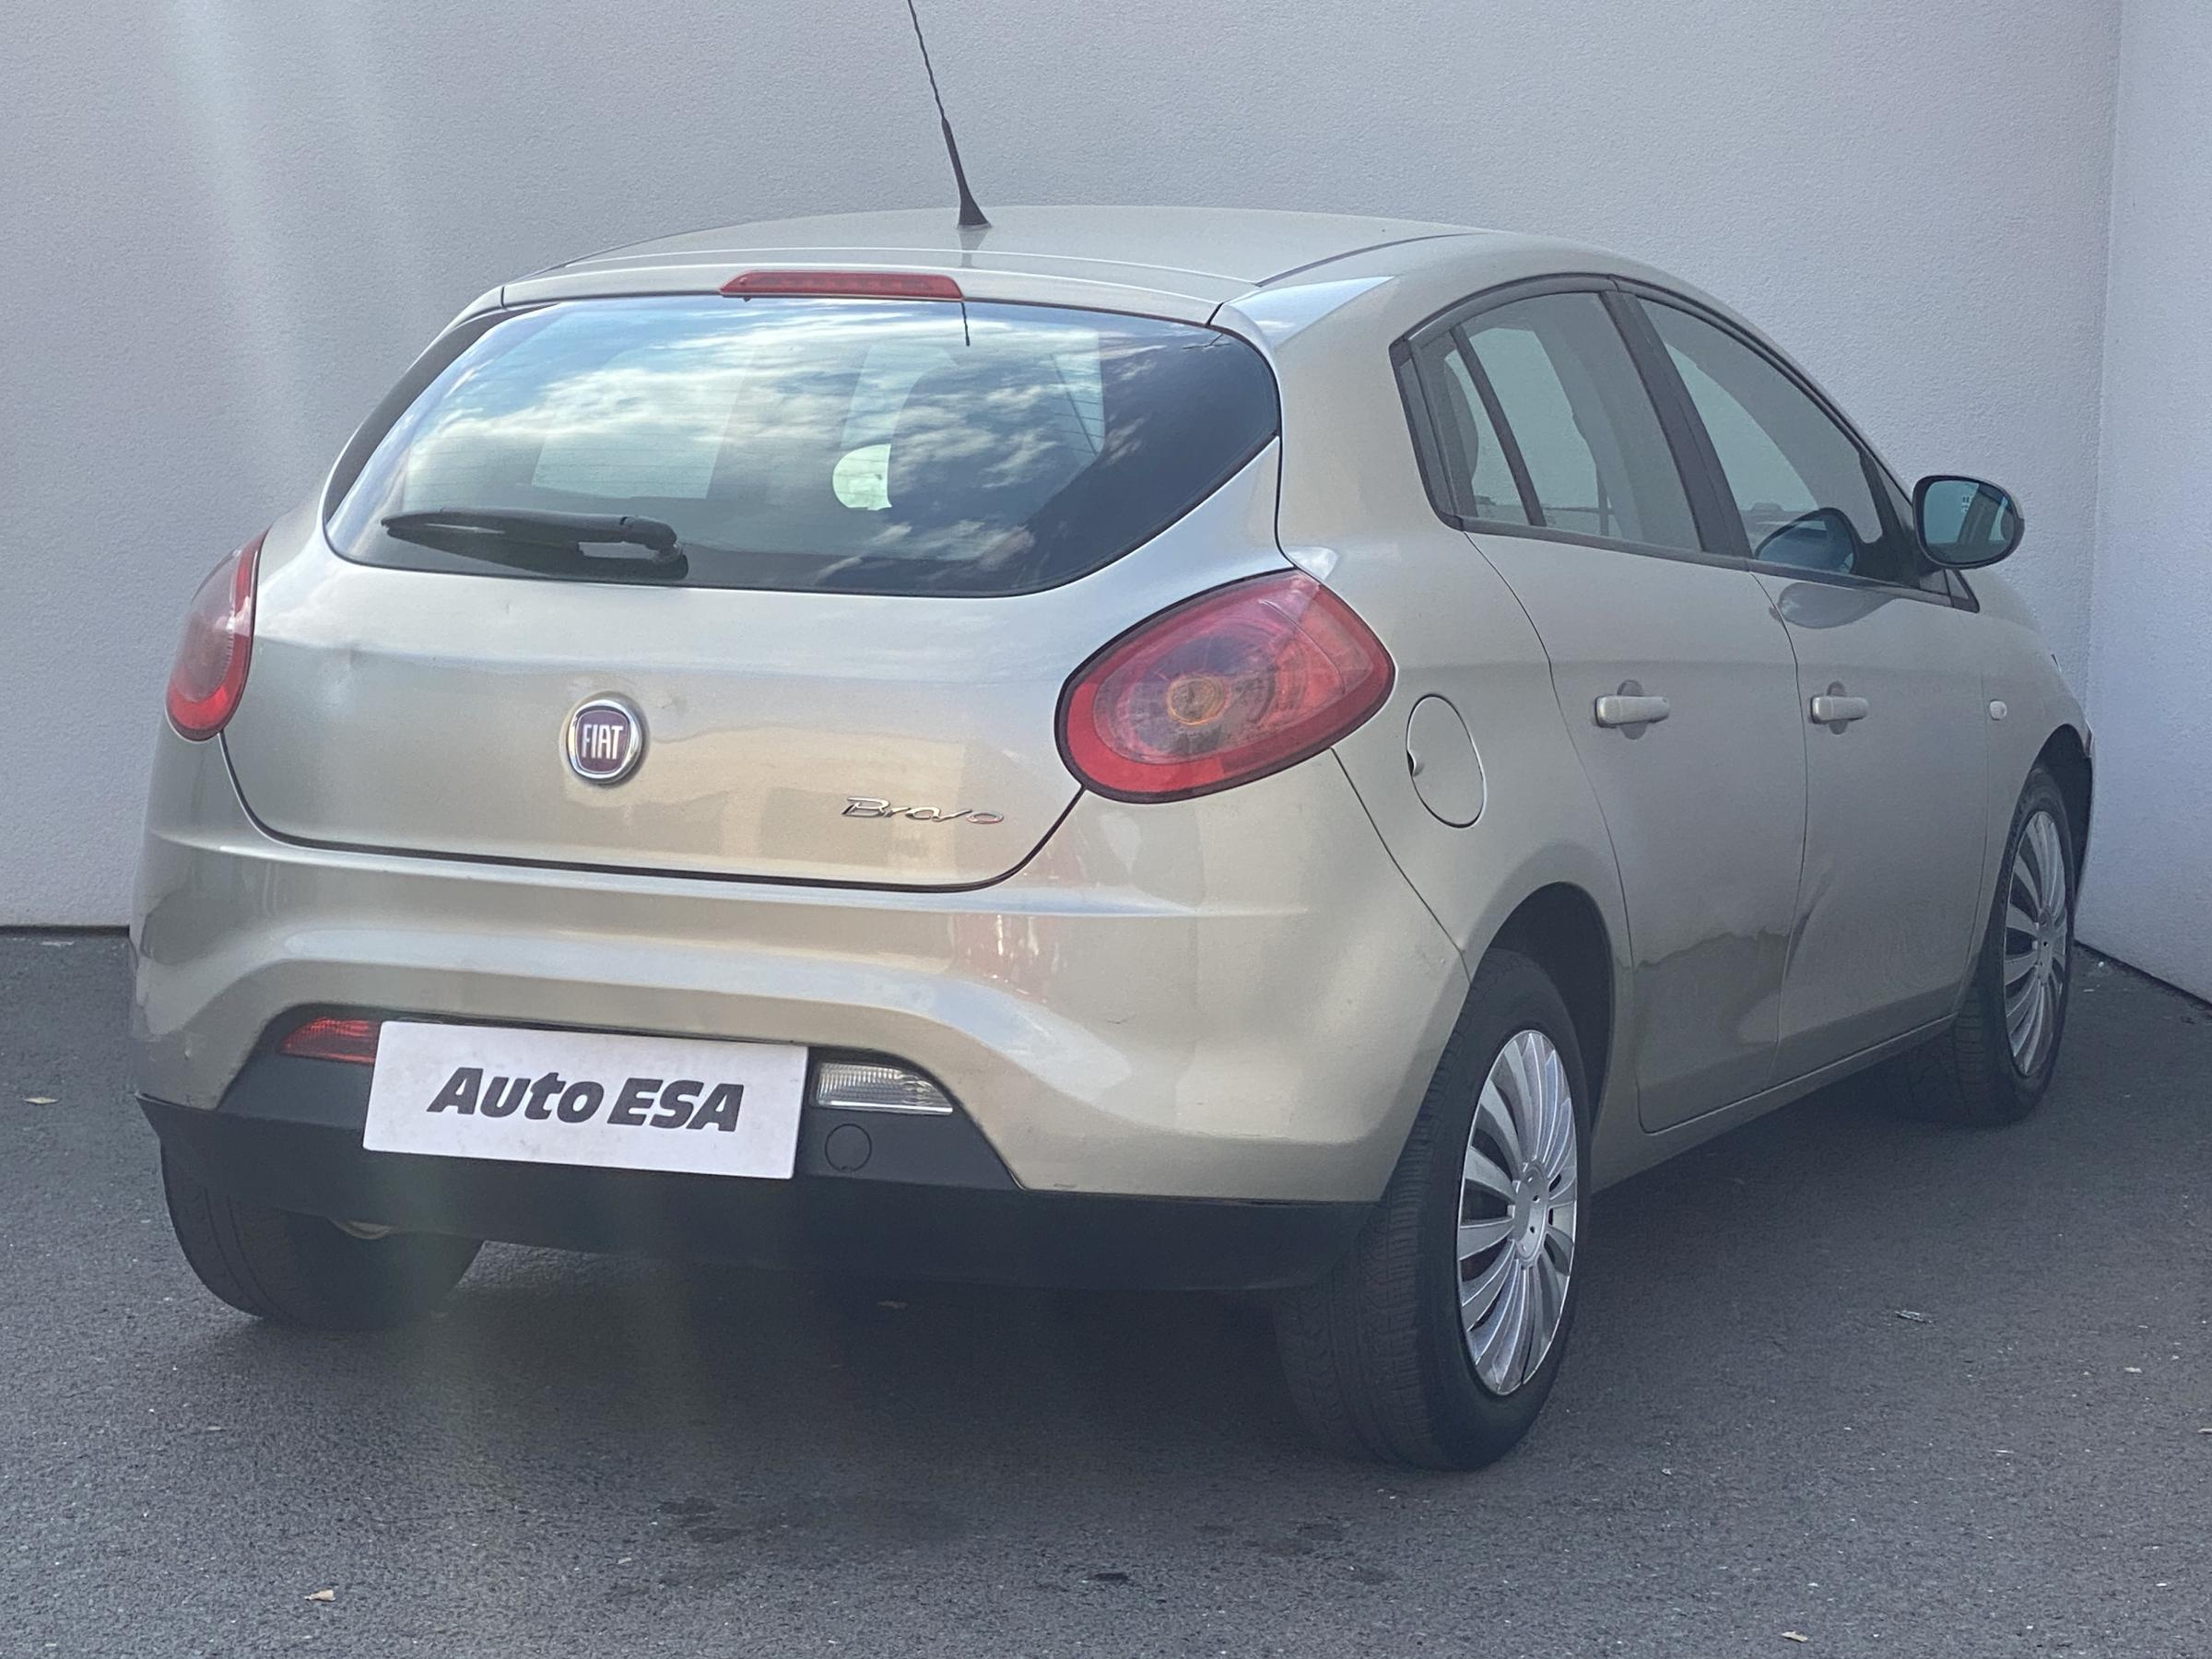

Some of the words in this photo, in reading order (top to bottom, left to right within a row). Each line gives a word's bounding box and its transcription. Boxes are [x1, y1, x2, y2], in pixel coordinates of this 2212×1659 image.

[581, 724, 624, 759] FIAT
[841, 796, 1005, 824] Bravo
[427, 1067, 604, 1123] Auto
[606, 1077, 745, 1132] ESA
